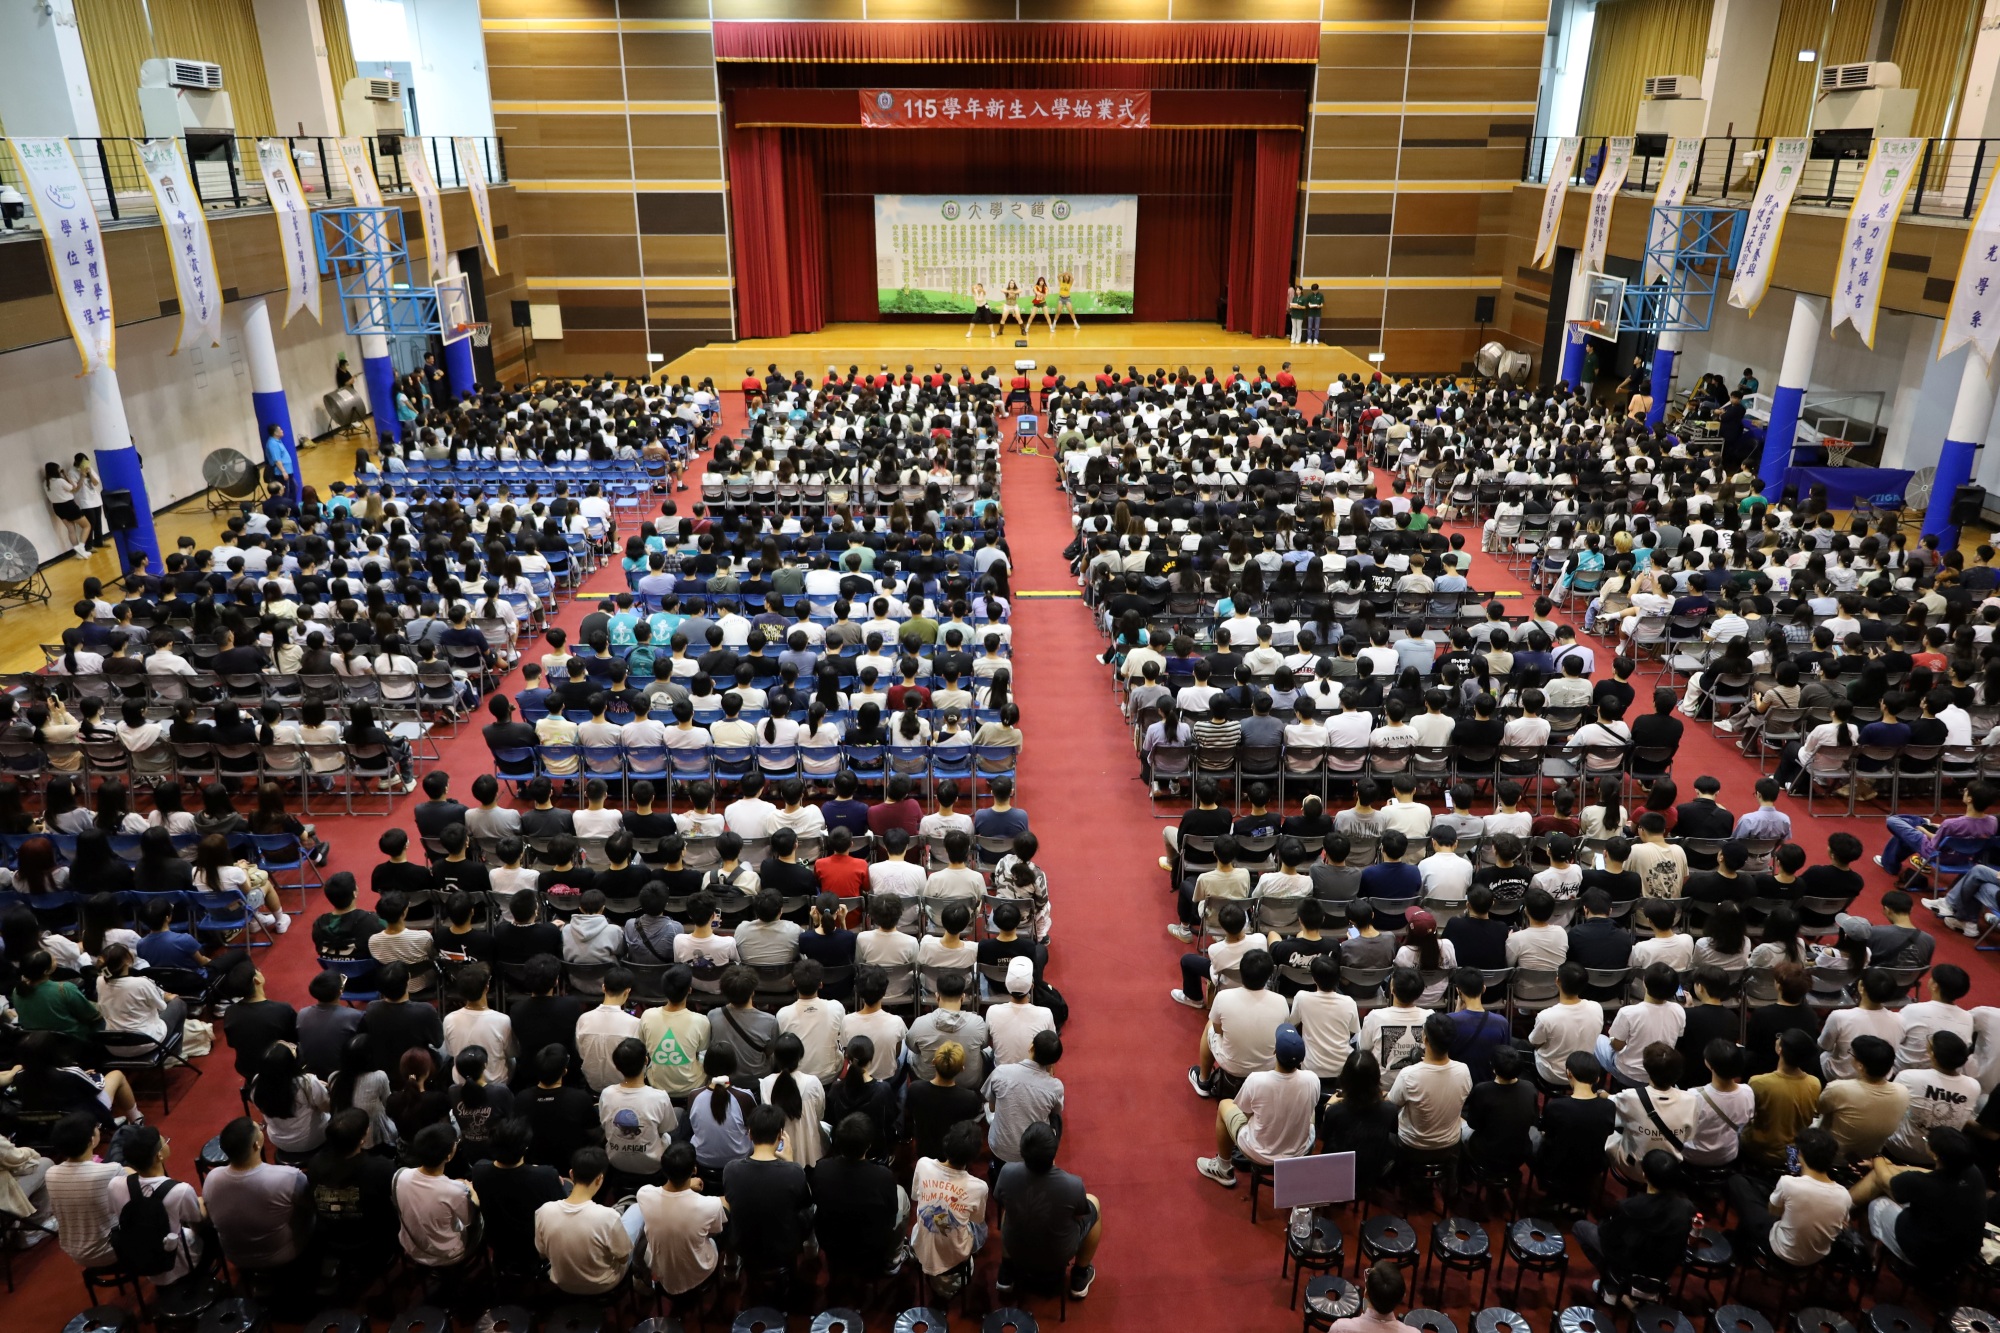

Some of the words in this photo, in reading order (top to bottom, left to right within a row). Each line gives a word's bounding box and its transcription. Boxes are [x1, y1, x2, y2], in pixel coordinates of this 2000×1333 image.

[903, 97, 1136, 121] 115學年新生入學始業式
[21, 141, 62, 158] 亞洲大學
[1778, 142, 1805, 154] 亞洲大學
[1881, 141, 1917, 155] 亞洲大學
[61, 219, 95, 325] 學位學程
[79, 217, 110, 321] 半導體學士
[1970, 222, 2000, 328] 光學系
